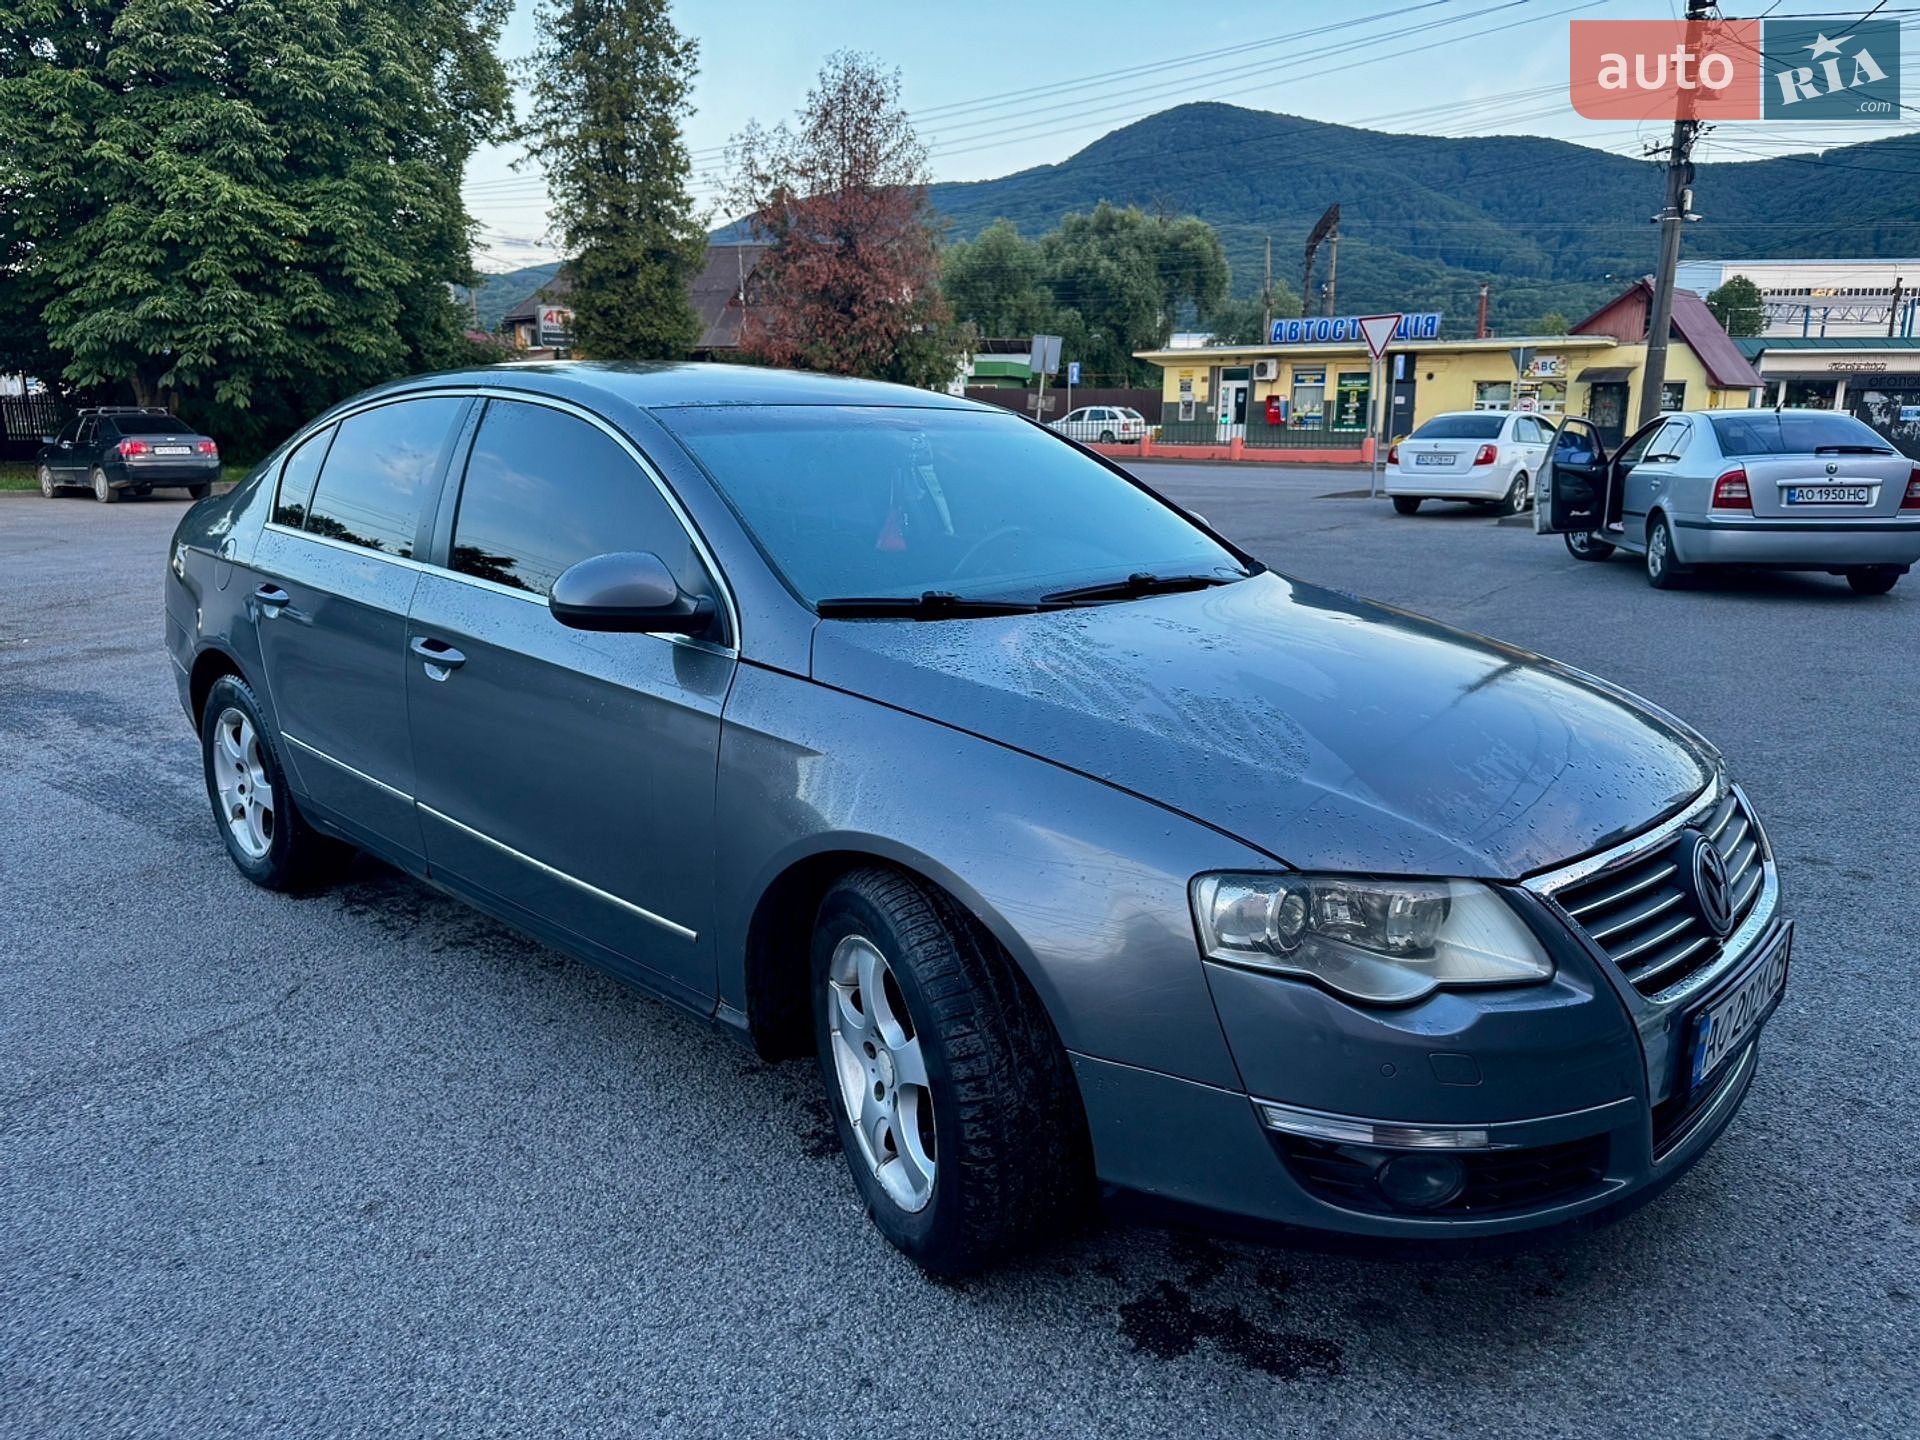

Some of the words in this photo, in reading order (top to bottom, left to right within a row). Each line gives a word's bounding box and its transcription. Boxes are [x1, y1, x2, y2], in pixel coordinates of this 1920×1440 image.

[1271, 314, 1440, 343] АВТОСТЦІЯ
[1532, 361, 1557, 372] ABC
[1797, 489, 1815, 500] AO
[1816, 489, 1846, 500] 1950
[1847, 489, 1865, 500] HC
